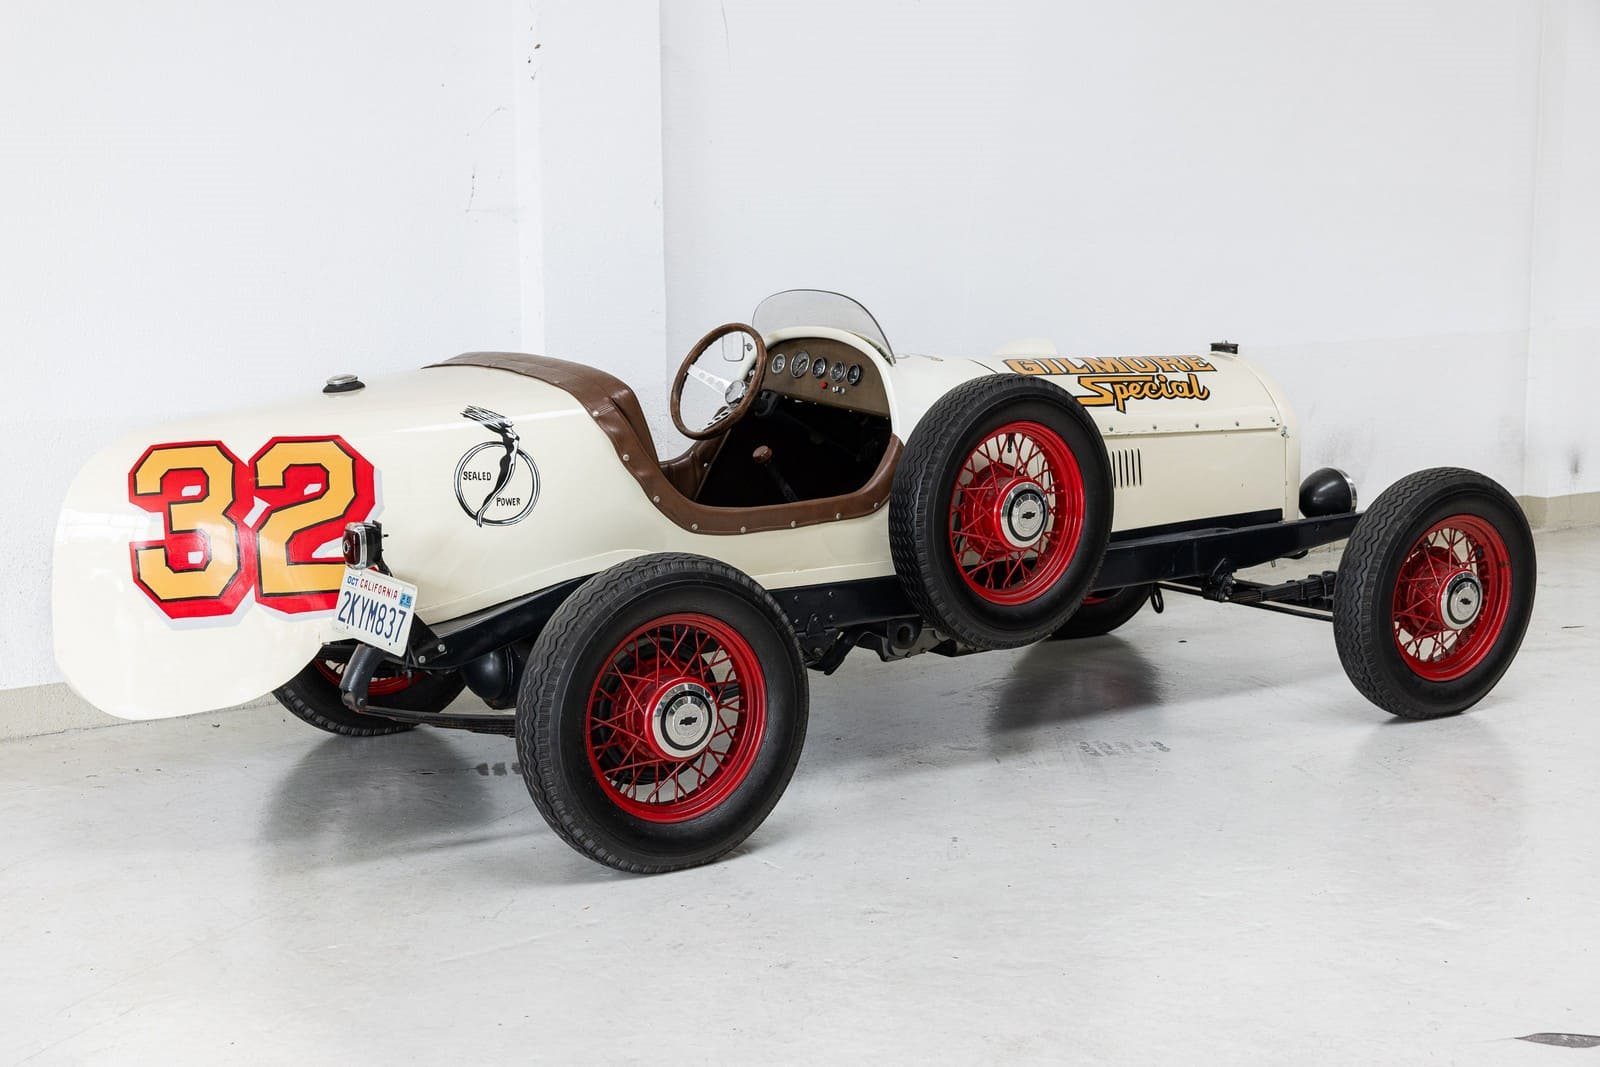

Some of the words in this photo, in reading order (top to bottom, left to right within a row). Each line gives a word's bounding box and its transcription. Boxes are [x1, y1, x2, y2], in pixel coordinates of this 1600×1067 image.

[1002, 355, 1218, 376] GILMORE
[1074, 373, 1211, 414] Special
[463, 471, 492, 481] SEALED
[496, 497, 521, 507] POWER
[128, 435, 376, 620] 32
[347, 575, 359, 587] OCT
[359, 578, 398, 600] CALIFORNIA
[338, 591, 407, 643] 2KYM837
